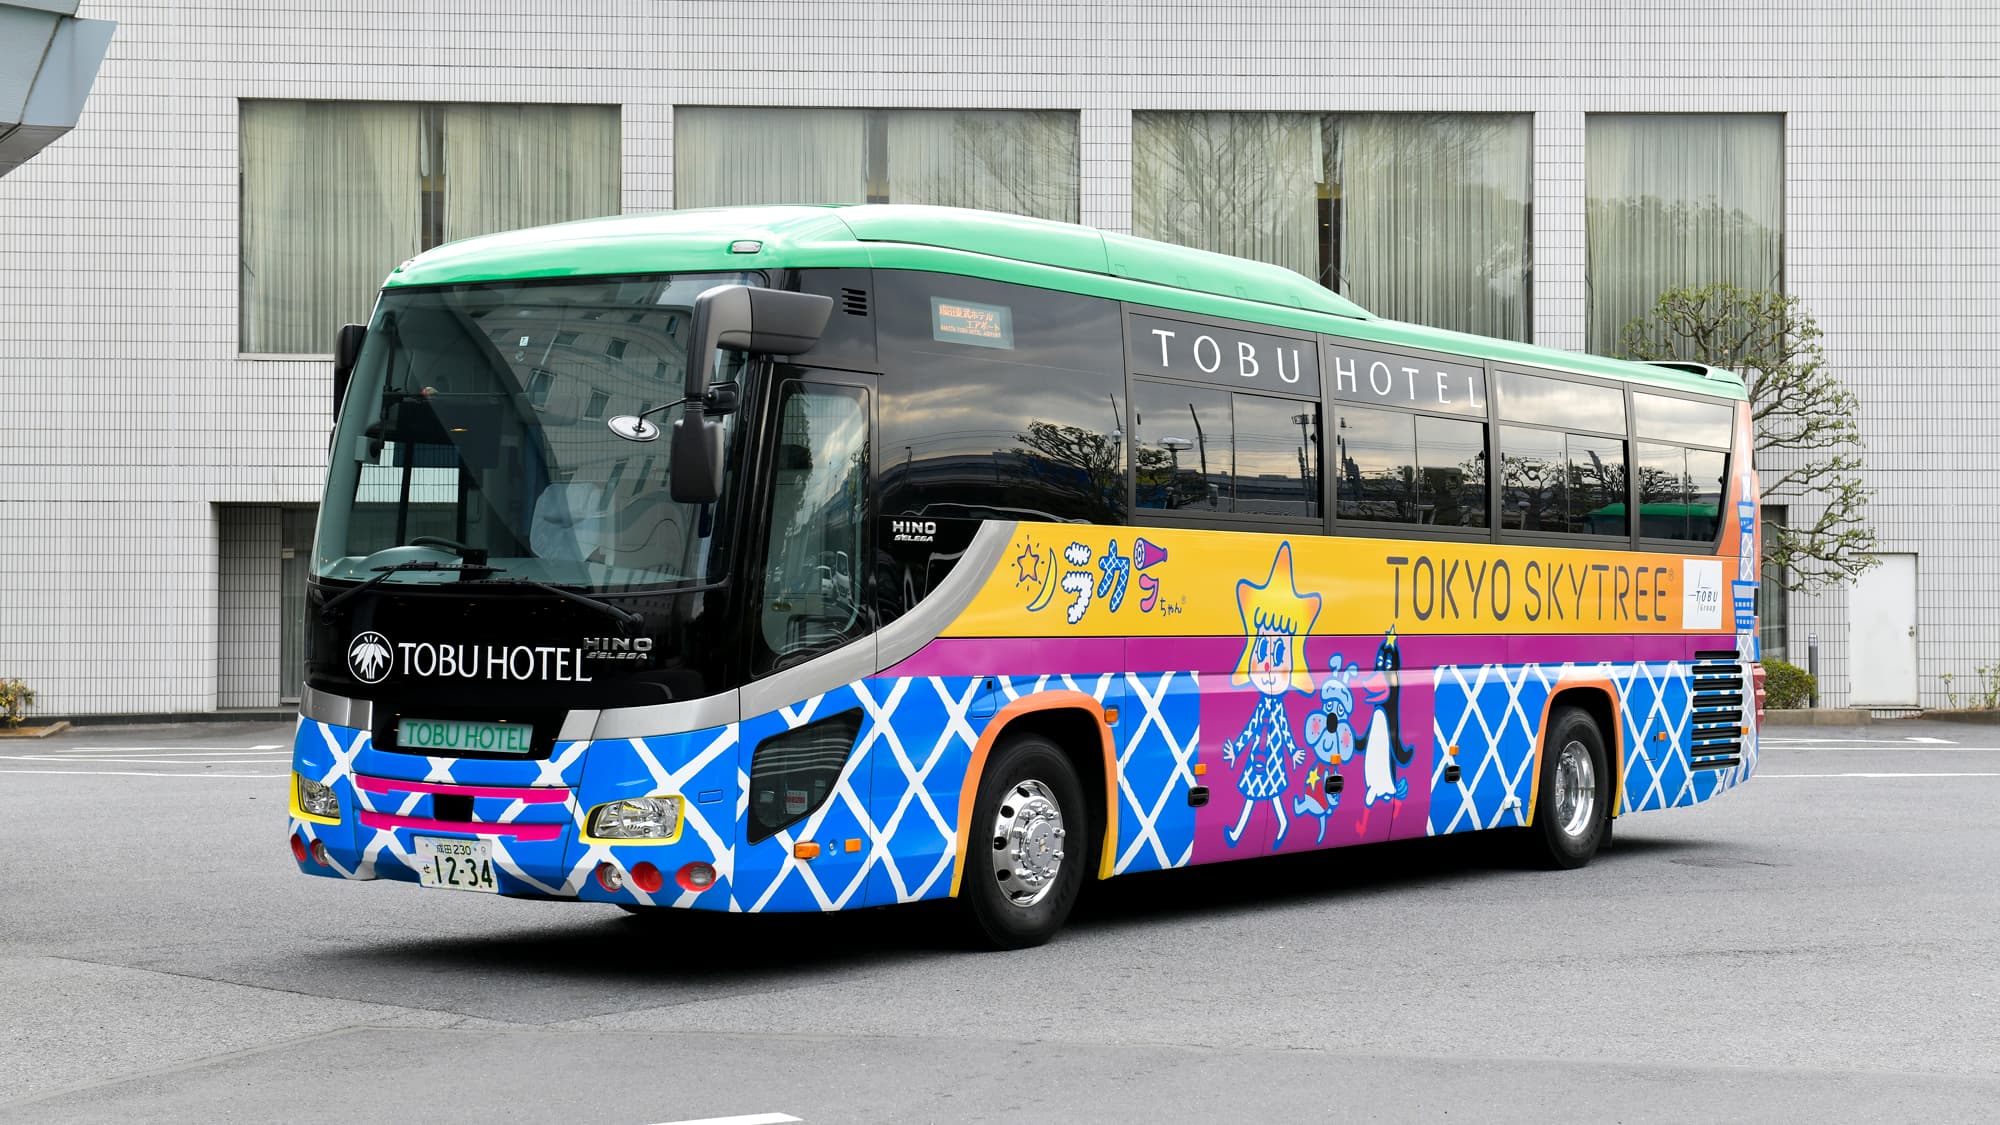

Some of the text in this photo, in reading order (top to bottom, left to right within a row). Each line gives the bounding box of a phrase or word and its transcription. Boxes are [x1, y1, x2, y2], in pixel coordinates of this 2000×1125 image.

[1151, 328, 1483, 409] TOBU HOTEL
[892, 520, 937, 535] HINO
[1386, 555, 1511, 622] TOKYO
[1696, 590, 1719, 602] TOBU
[583, 637, 653, 652] HINO
[398, 642, 593, 682] TOBU HOTEL
[405, 721, 529, 751] TOBU HOTEL
[453, 844, 472, 856] 230
[434, 855, 493, 888] 12-34
